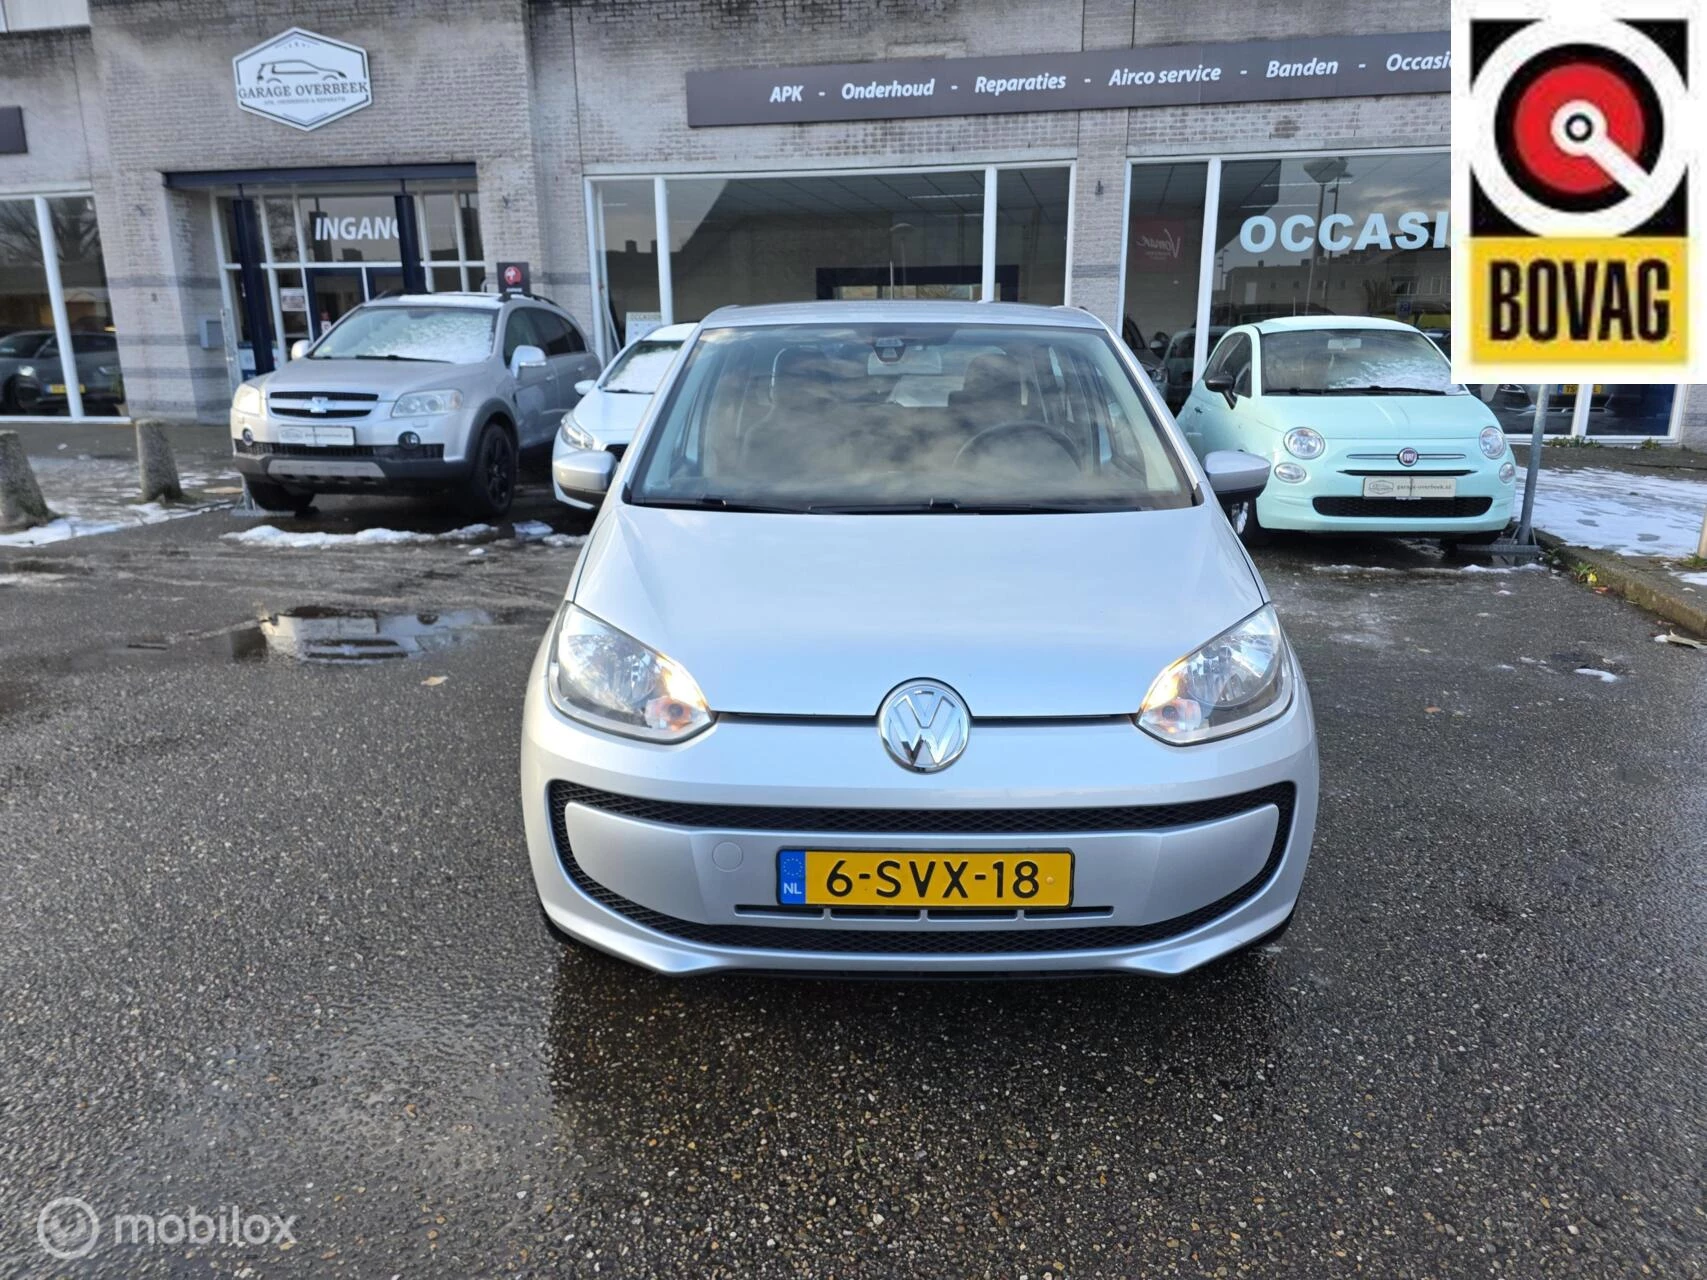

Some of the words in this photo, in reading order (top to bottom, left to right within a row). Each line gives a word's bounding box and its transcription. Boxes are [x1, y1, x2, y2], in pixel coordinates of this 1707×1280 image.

[238, 84, 292, 99] GARAGE
[295, 81, 369, 96] OVERBEEK
[770, 86, 804, 103] APK
[842, 78, 935, 100] Onderhoud
[975, 73, 1066, 97] Reparaties
[1108, 69, 1156, 87] Airco
[1158, 64, 1222, 84] service
[1266, 58, 1339, 79] Banden
[783, 881, 803, 895] NL
[825, 859, 1041, 899] 6-SVX-18
